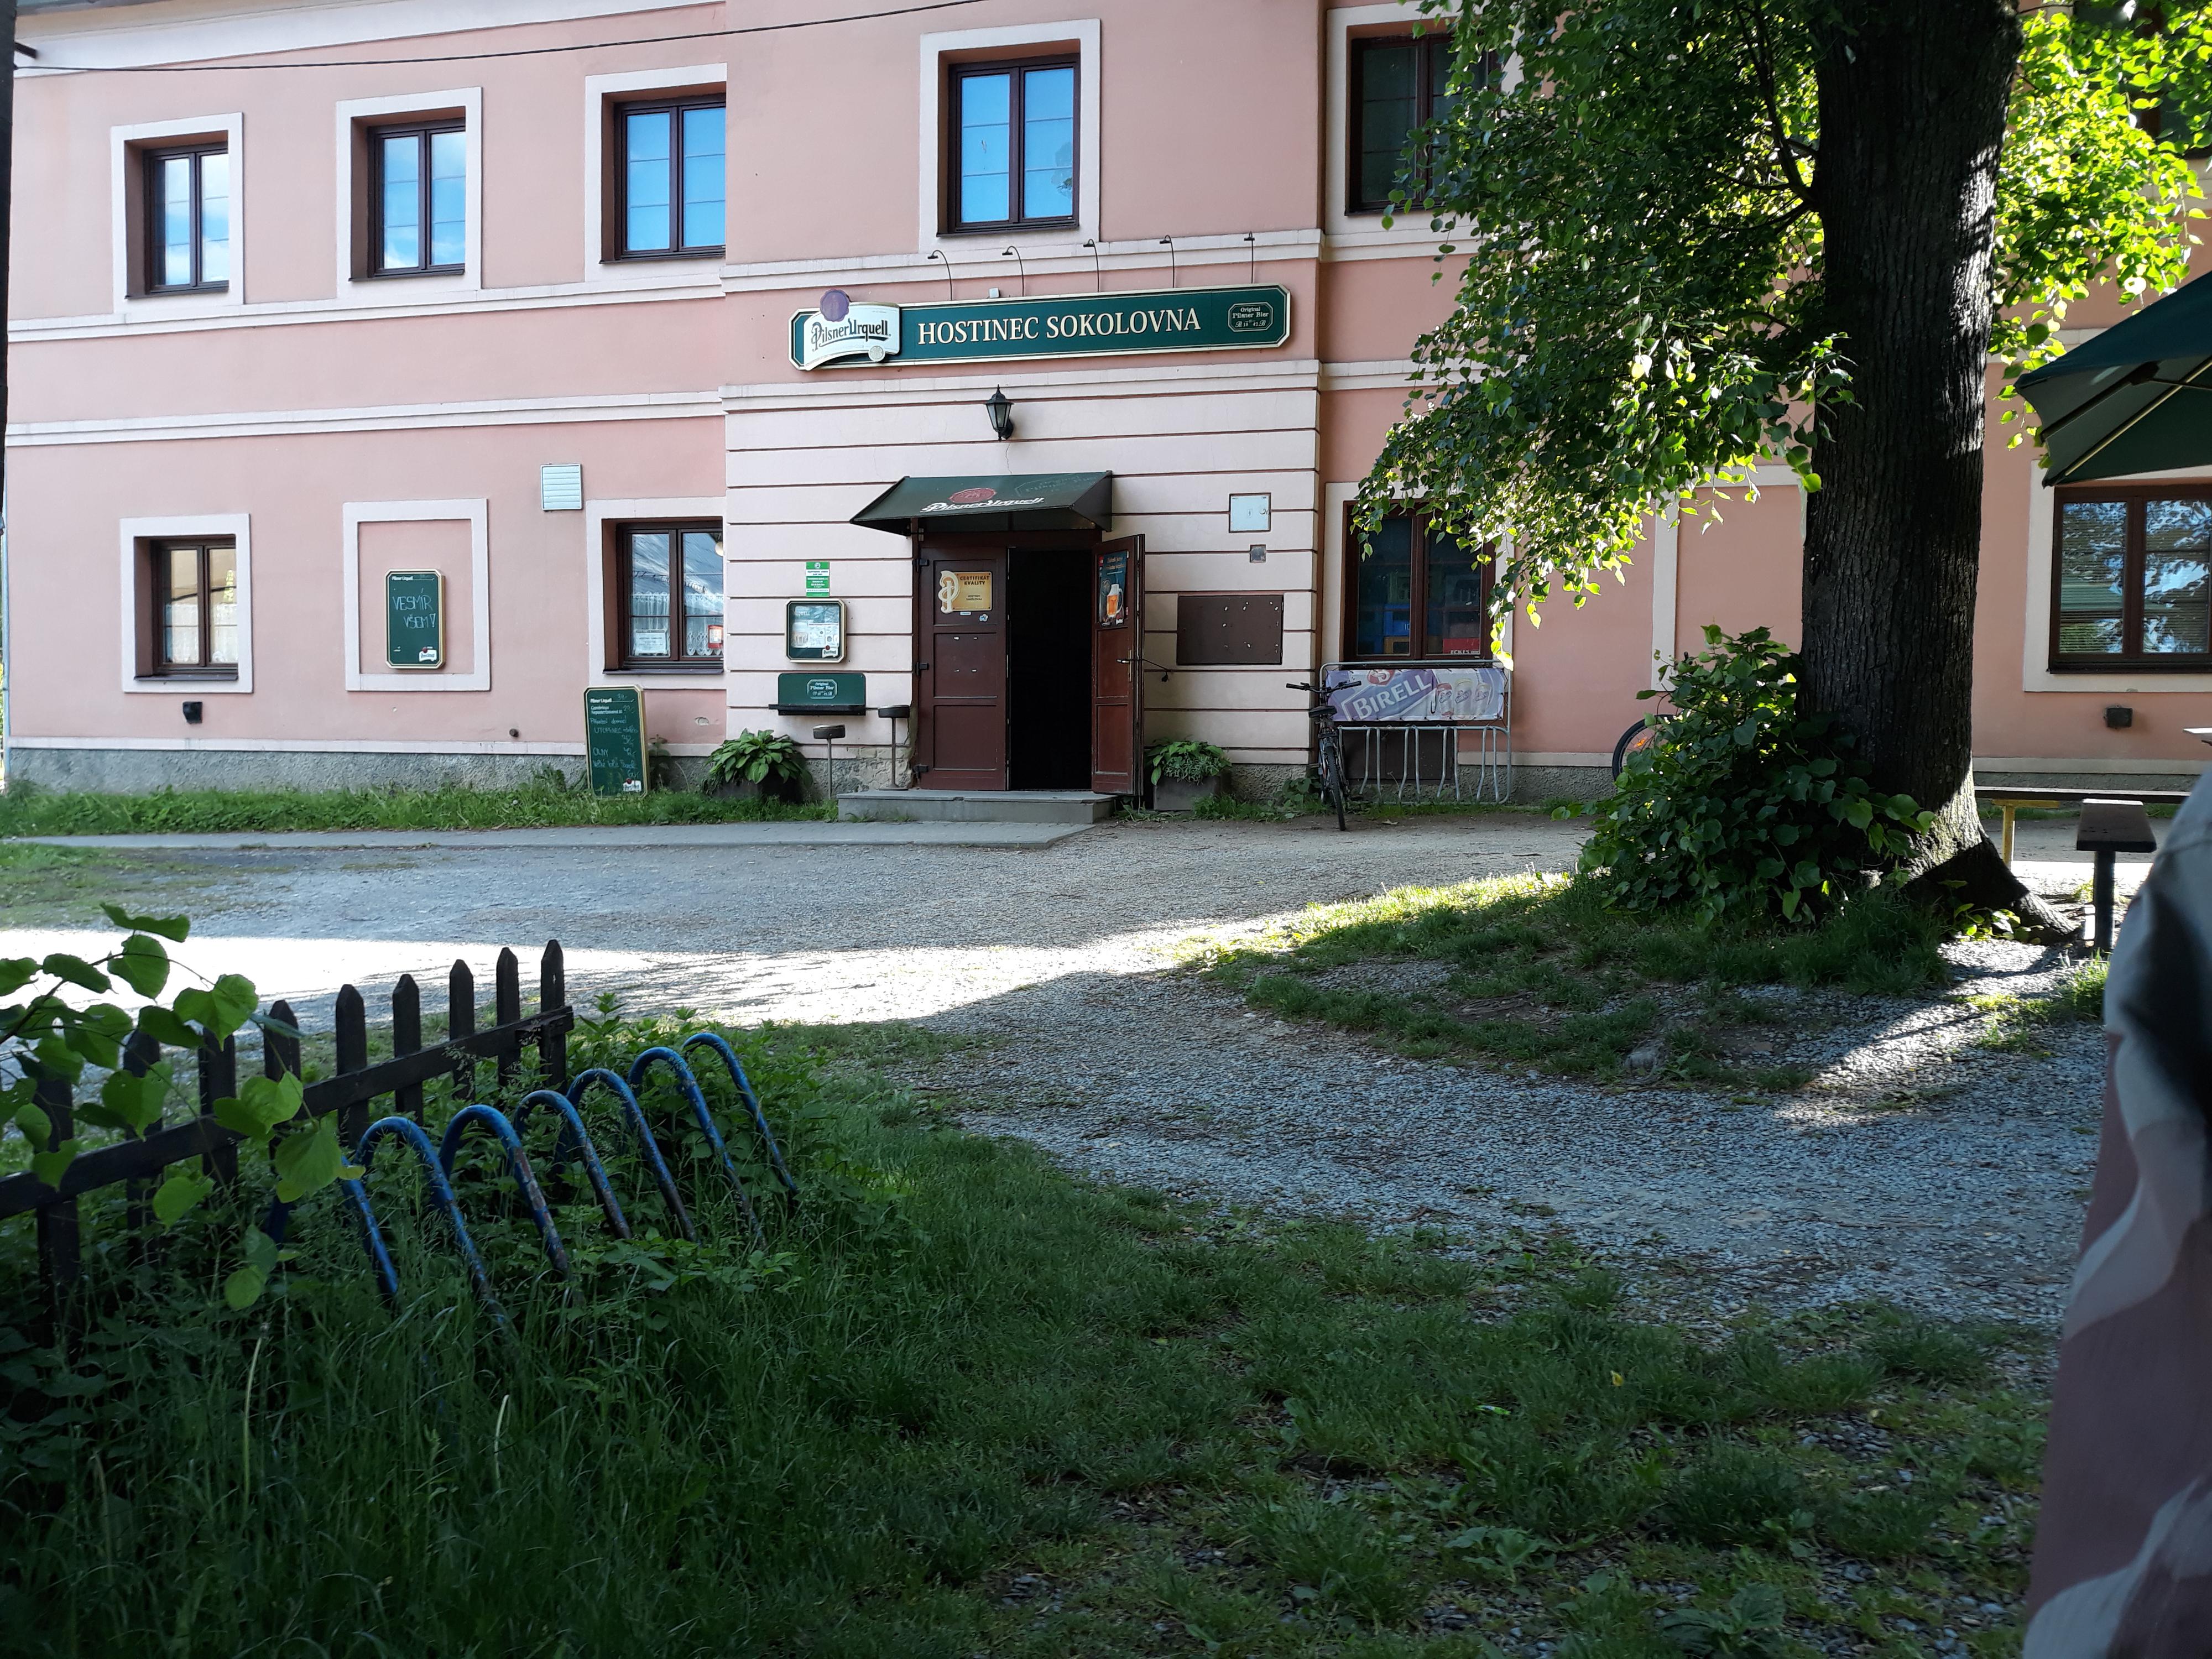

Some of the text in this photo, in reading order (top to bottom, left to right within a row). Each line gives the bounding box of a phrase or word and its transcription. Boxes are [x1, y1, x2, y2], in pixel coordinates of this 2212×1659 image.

[811, 318, 889, 352] Pilsner Urquell
[918, 307, 1201, 345] HOSTINEC SOKOLOVNA
[920, 498, 1044, 513] Pilsner Urquell
[392, 588, 433, 611] VESMÍR
[1353, 675, 1432, 719] BIRELL
